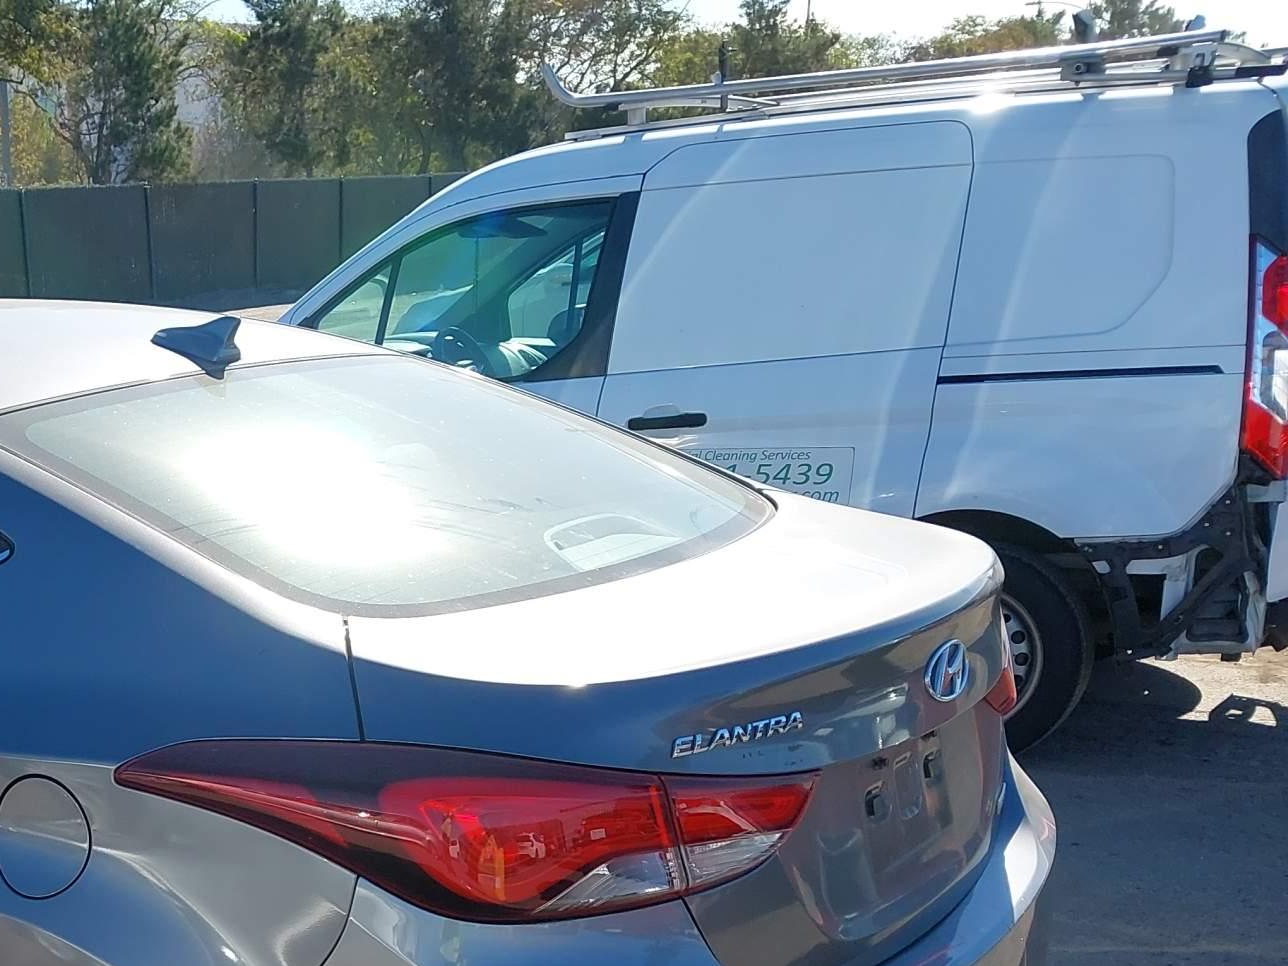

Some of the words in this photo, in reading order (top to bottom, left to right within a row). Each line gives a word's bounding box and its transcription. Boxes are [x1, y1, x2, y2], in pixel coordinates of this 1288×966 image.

[705, 450, 758, 463] Cleaning
[761, 450, 811, 461] Services
[672, 711, 804, 758] ELANTRA
